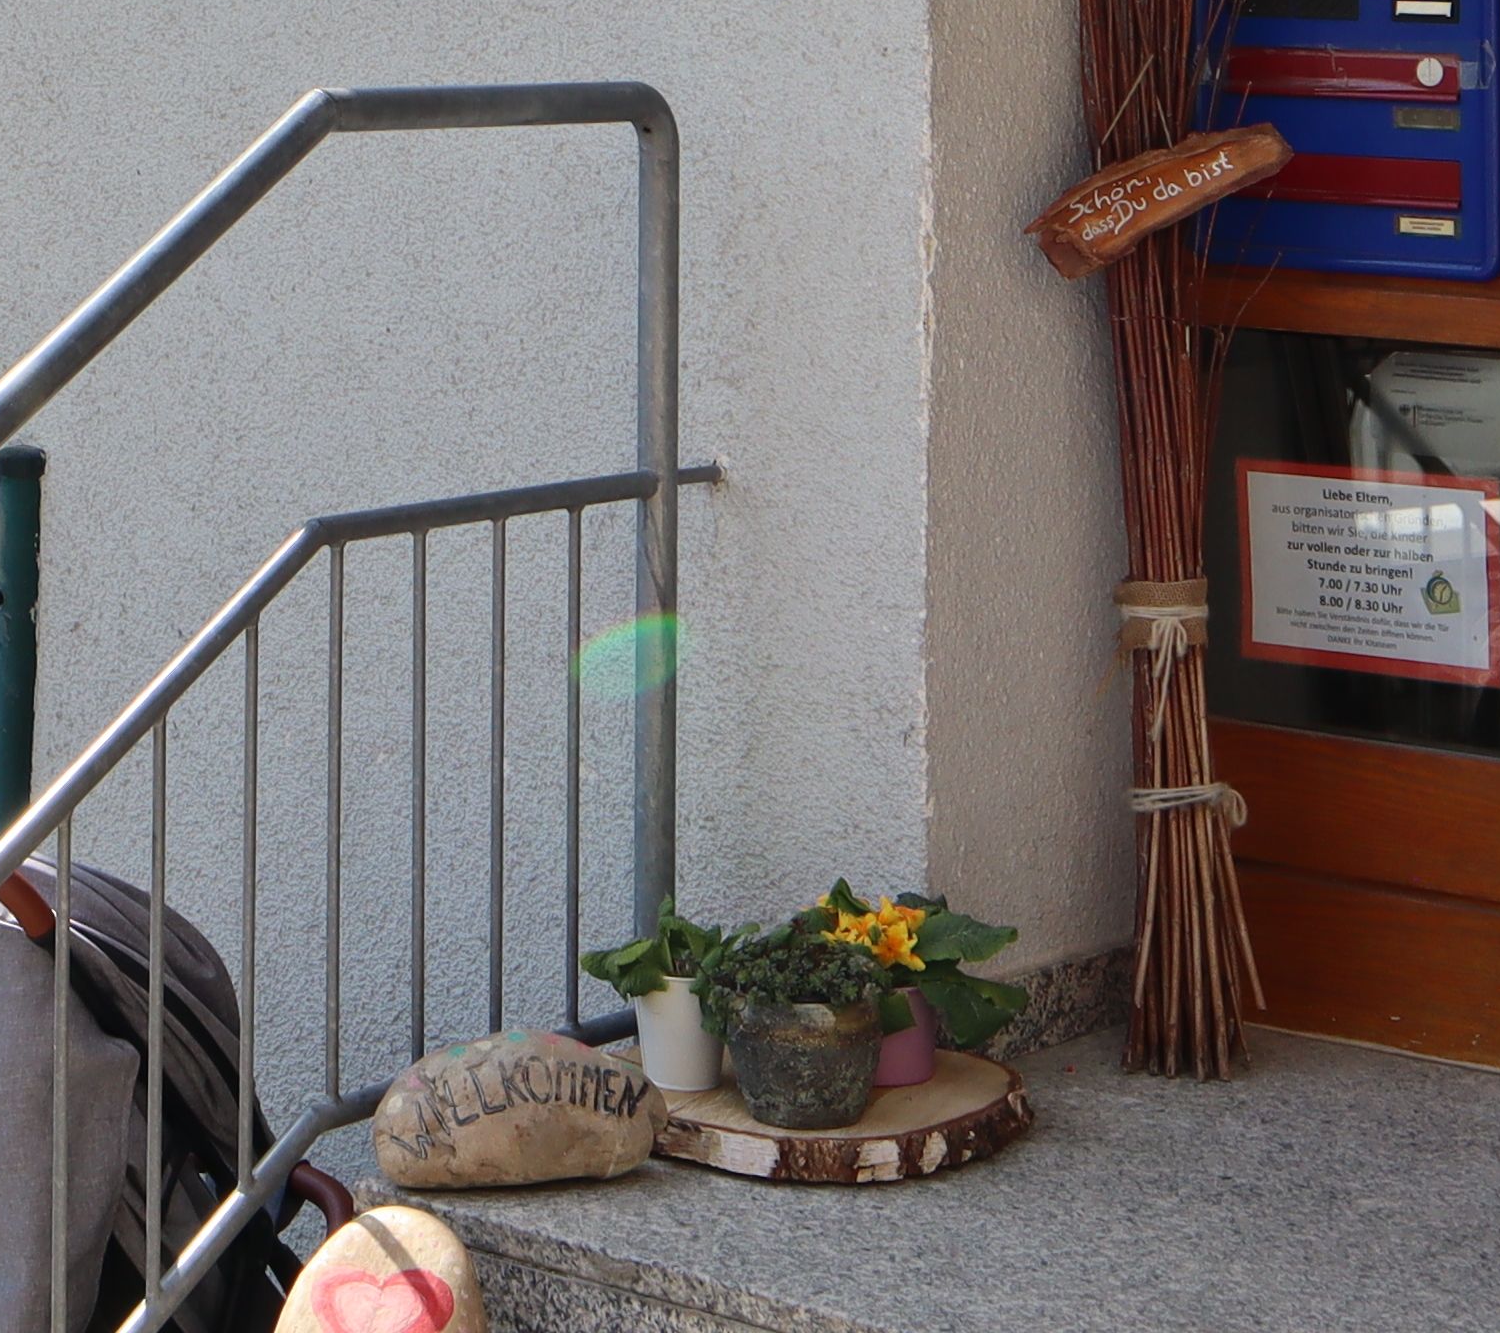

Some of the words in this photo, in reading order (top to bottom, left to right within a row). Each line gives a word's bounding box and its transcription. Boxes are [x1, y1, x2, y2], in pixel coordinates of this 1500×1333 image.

[1068, 175, 1151, 223] Schön,
[1082, 214, 1115, 241] dass
[1110, 196, 1147, 234] Du
[1153, 179, 1183, 201] da
[1184, 150, 1234, 187] bist
[1323, 489, 1352, 501] Liebe
[1356, 492, 1393, 506] Eltern,
[1272, 504, 1290, 514] aus
[1292, 521, 1324, 534] bitten
[1328, 525, 1344, 536] wir
[1348, 528, 1368, 541] Sie,
[1391, 532, 1427, 544] Kinder
[1287, 541, 1304, 550] zur
[1306, 541, 1341, 555] vollen
[1344, 545, 1370, 557] oder
[1373, 549, 1391, 558] zur
[1394, 549, 1433, 562] halben
[1307, 559, 1346, 572] Stunde
[1350, 565, 1363, 574] zu
[1366, 565, 1413, 580] bringen!
[1318, 578, 1342, 589] 7.00
[1354, 582, 1378, 593] 7.30
[1382, 584, 1402, 596] Uhr
[1320, 596, 1343, 608] 8.00
[1355, 599, 1379, 611] 8.30
[1382, 601, 1403, 614] Uhr
[1330, 612, 1370, 624] Verständnis
[1309, 621, 1341, 632] zwischen
[1343, 624, 1355, 633] den
[1357, 625, 1379, 636] Zeiten
[390, 1055, 649, 1160] WILLKOMMEN
